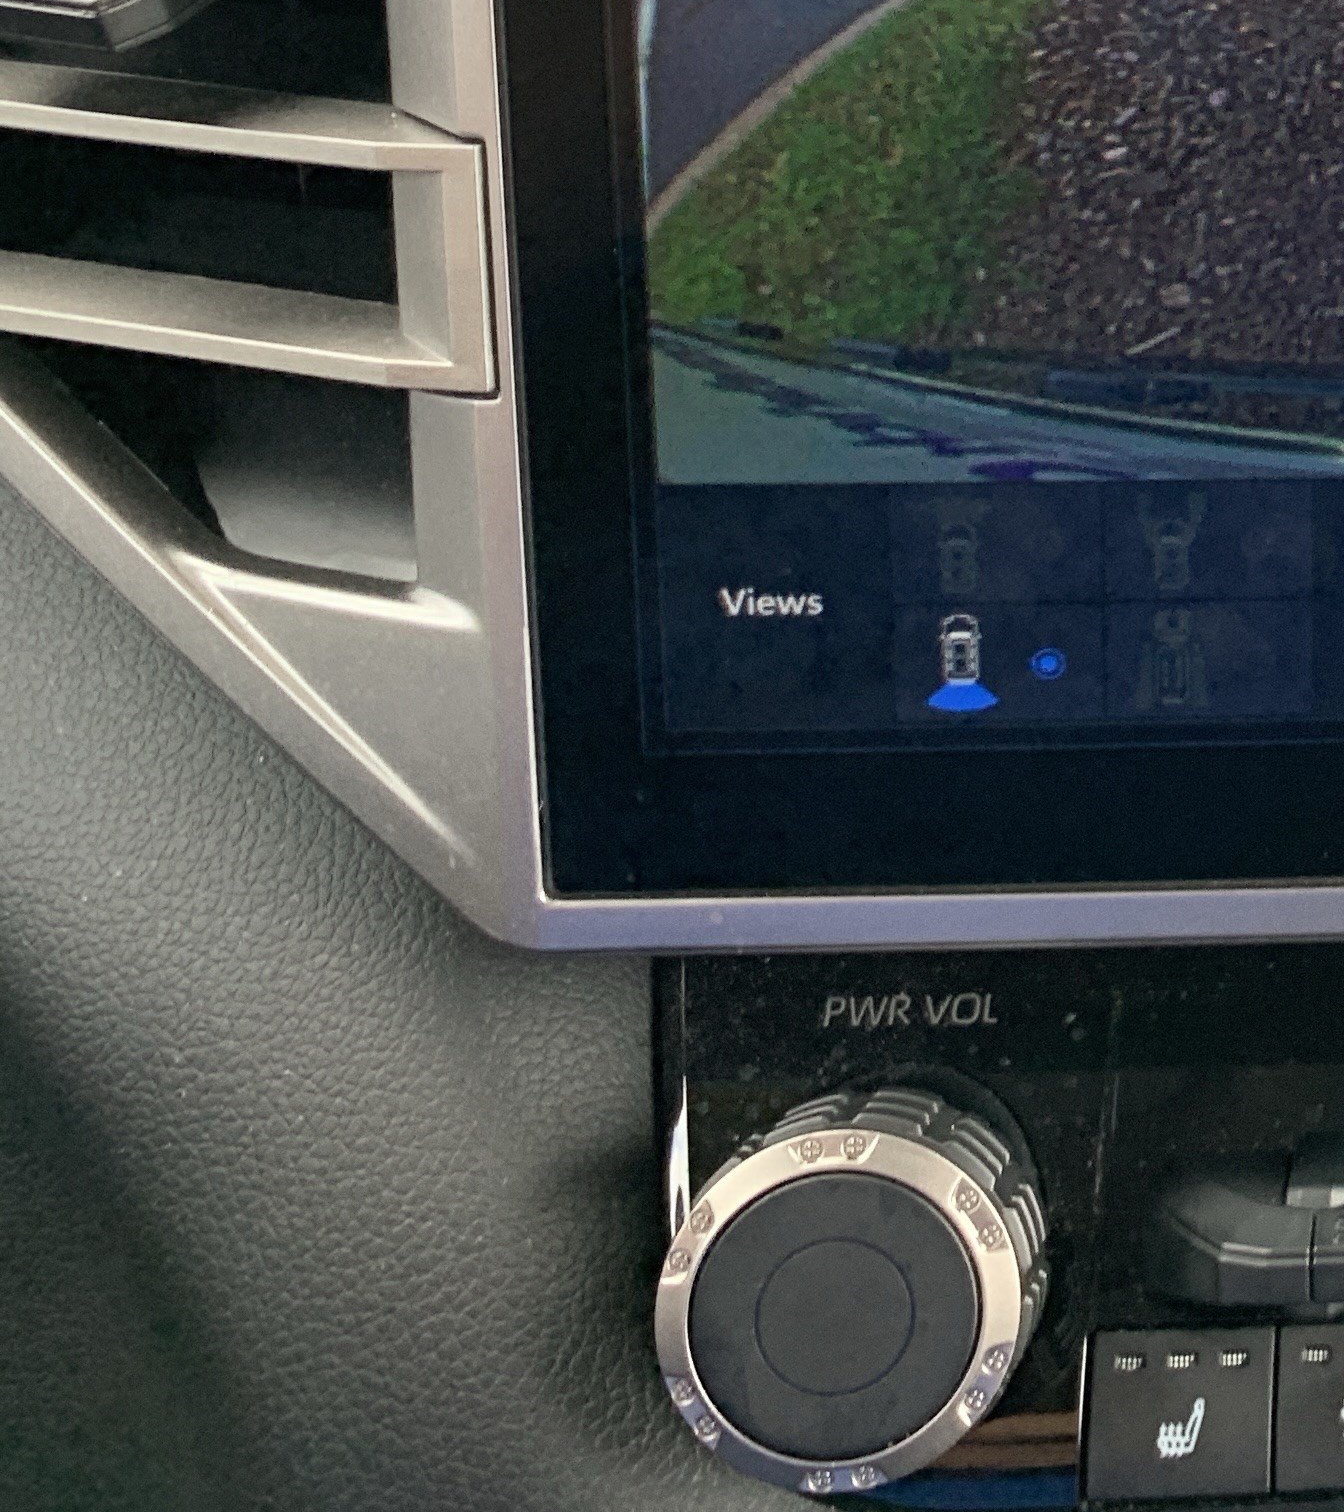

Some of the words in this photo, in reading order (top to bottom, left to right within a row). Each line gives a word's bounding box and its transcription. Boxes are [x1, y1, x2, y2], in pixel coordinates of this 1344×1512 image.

[718, 584, 824, 618] Views
[823, 995, 911, 1028] PWR
[925, 992, 1000, 1027] VOL
